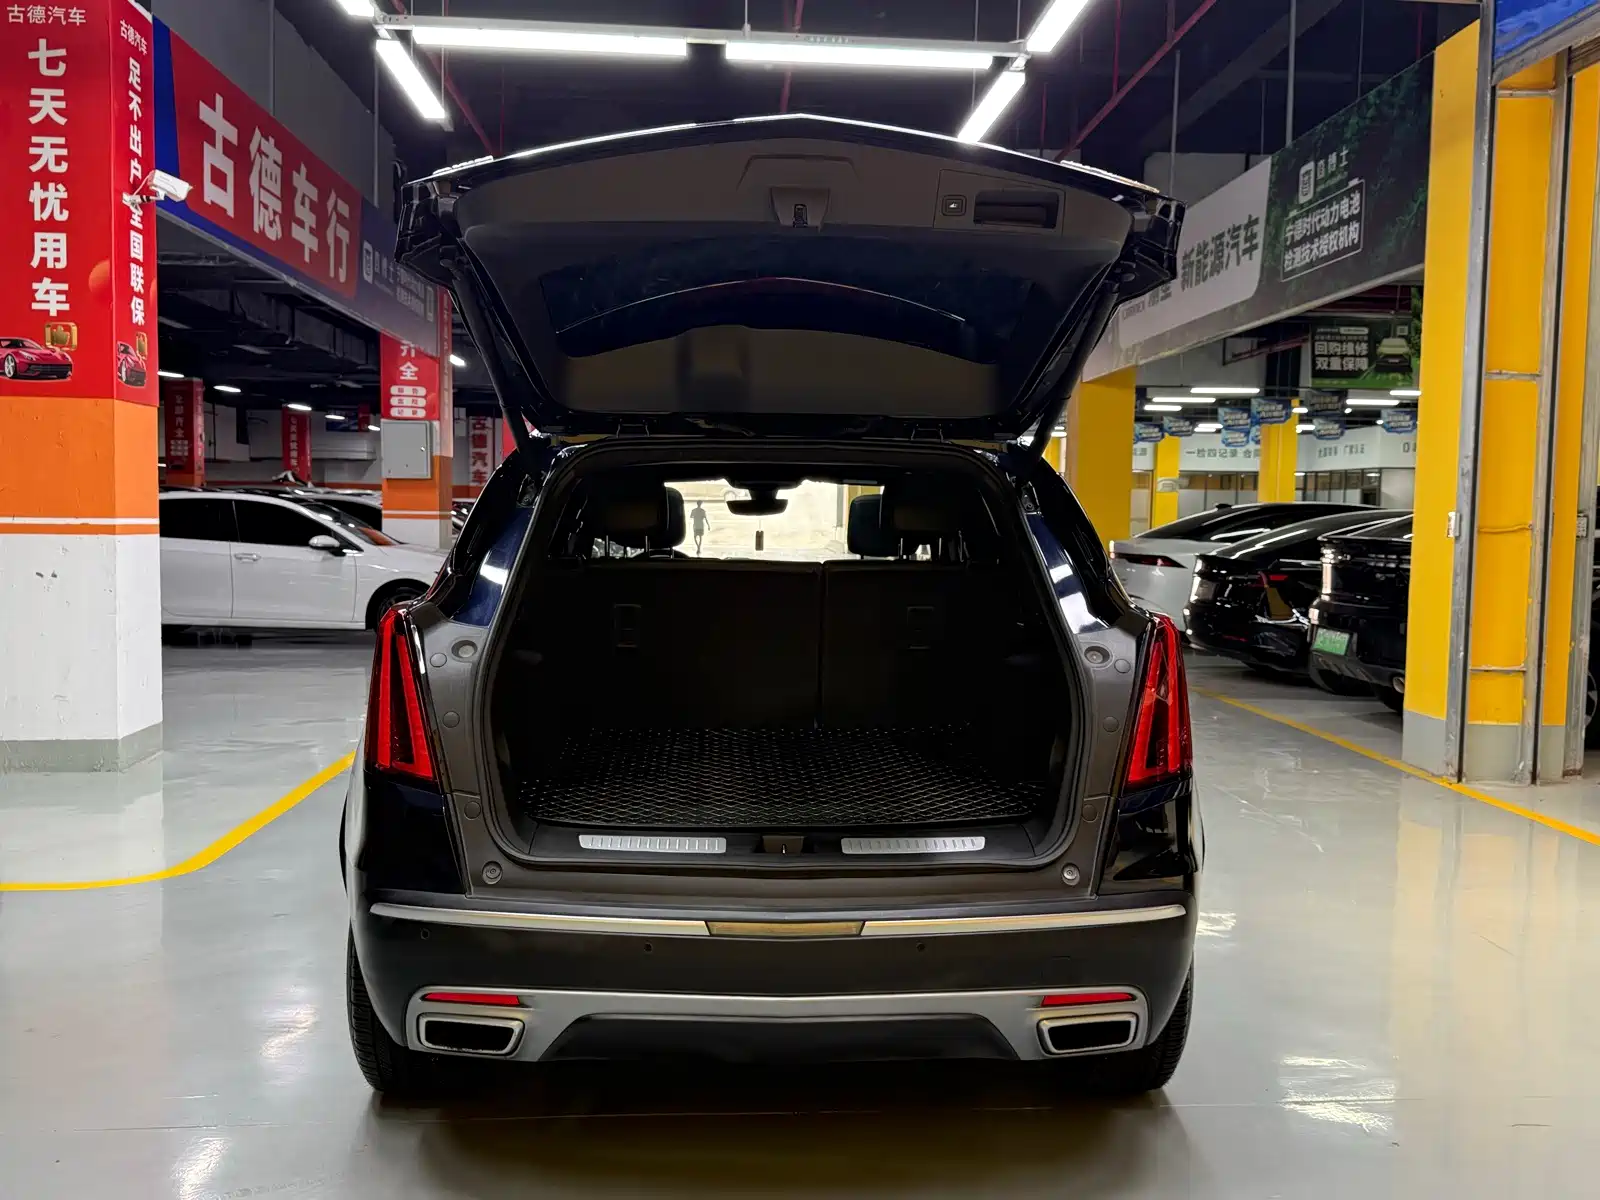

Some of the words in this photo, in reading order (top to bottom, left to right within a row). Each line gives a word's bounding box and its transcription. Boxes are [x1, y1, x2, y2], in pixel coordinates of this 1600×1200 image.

[6, 3, 87, 26] 古德汽车
[119, 19, 148, 56] 古德汽车
[127, 56, 143, 184] 足不出户
[27, 38, 70, 317] 七天无忧用车
[199, 92, 350, 284] 古德车行
[1285, 190, 1361, 245] 宁德时代动力电池
[129, 199, 146, 326] 全国联保
[1181, 213, 1259, 292] 新能源汽车
